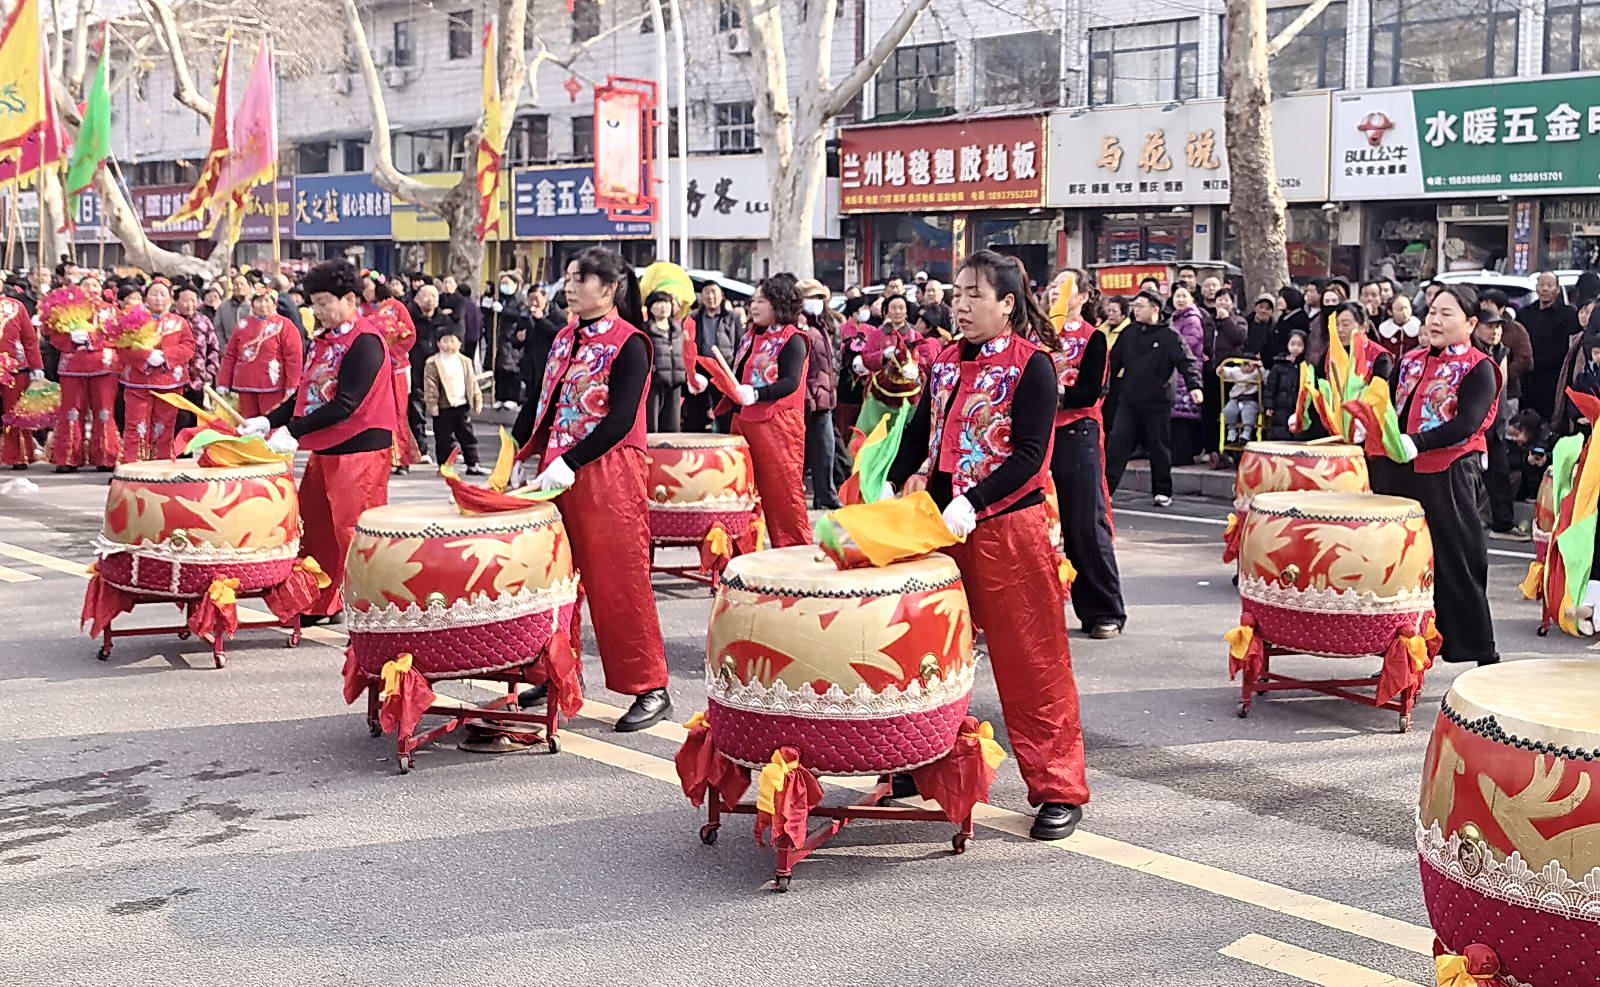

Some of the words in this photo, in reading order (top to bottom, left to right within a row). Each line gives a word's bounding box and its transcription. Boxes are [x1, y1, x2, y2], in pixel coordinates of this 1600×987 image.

[842, 140, 1036, 188] 兰州地毯塑胶地板
[1096, 128, 1221, 173] 与花说
